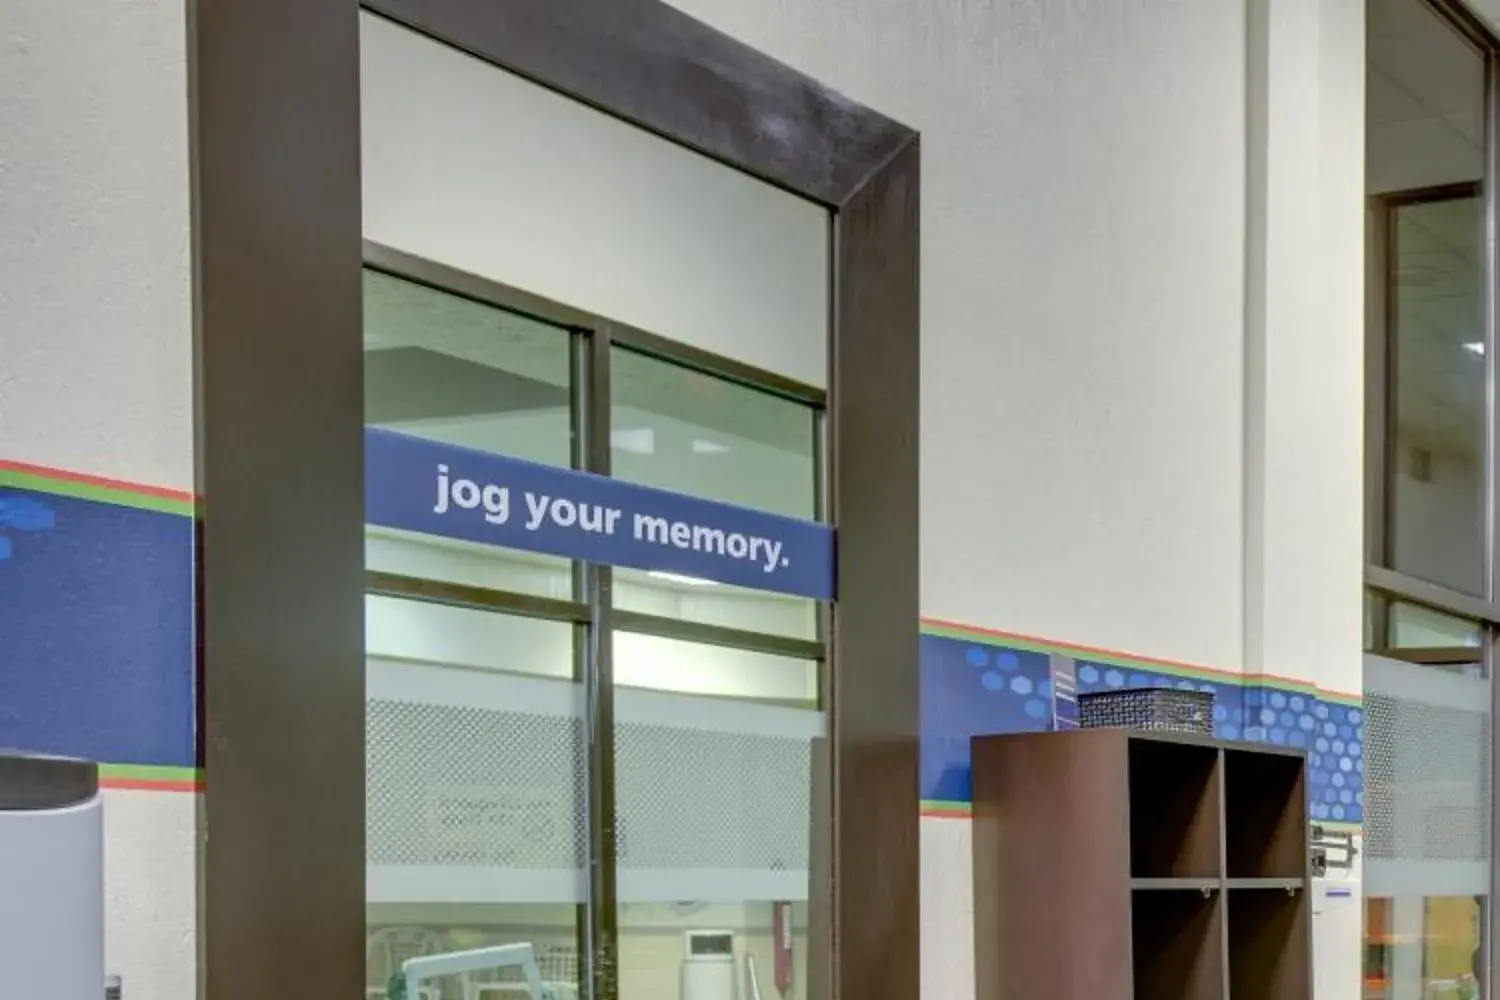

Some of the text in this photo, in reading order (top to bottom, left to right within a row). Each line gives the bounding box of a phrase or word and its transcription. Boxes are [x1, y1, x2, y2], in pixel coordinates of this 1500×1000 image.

[433, 463, 790, 573] jog your memory.
